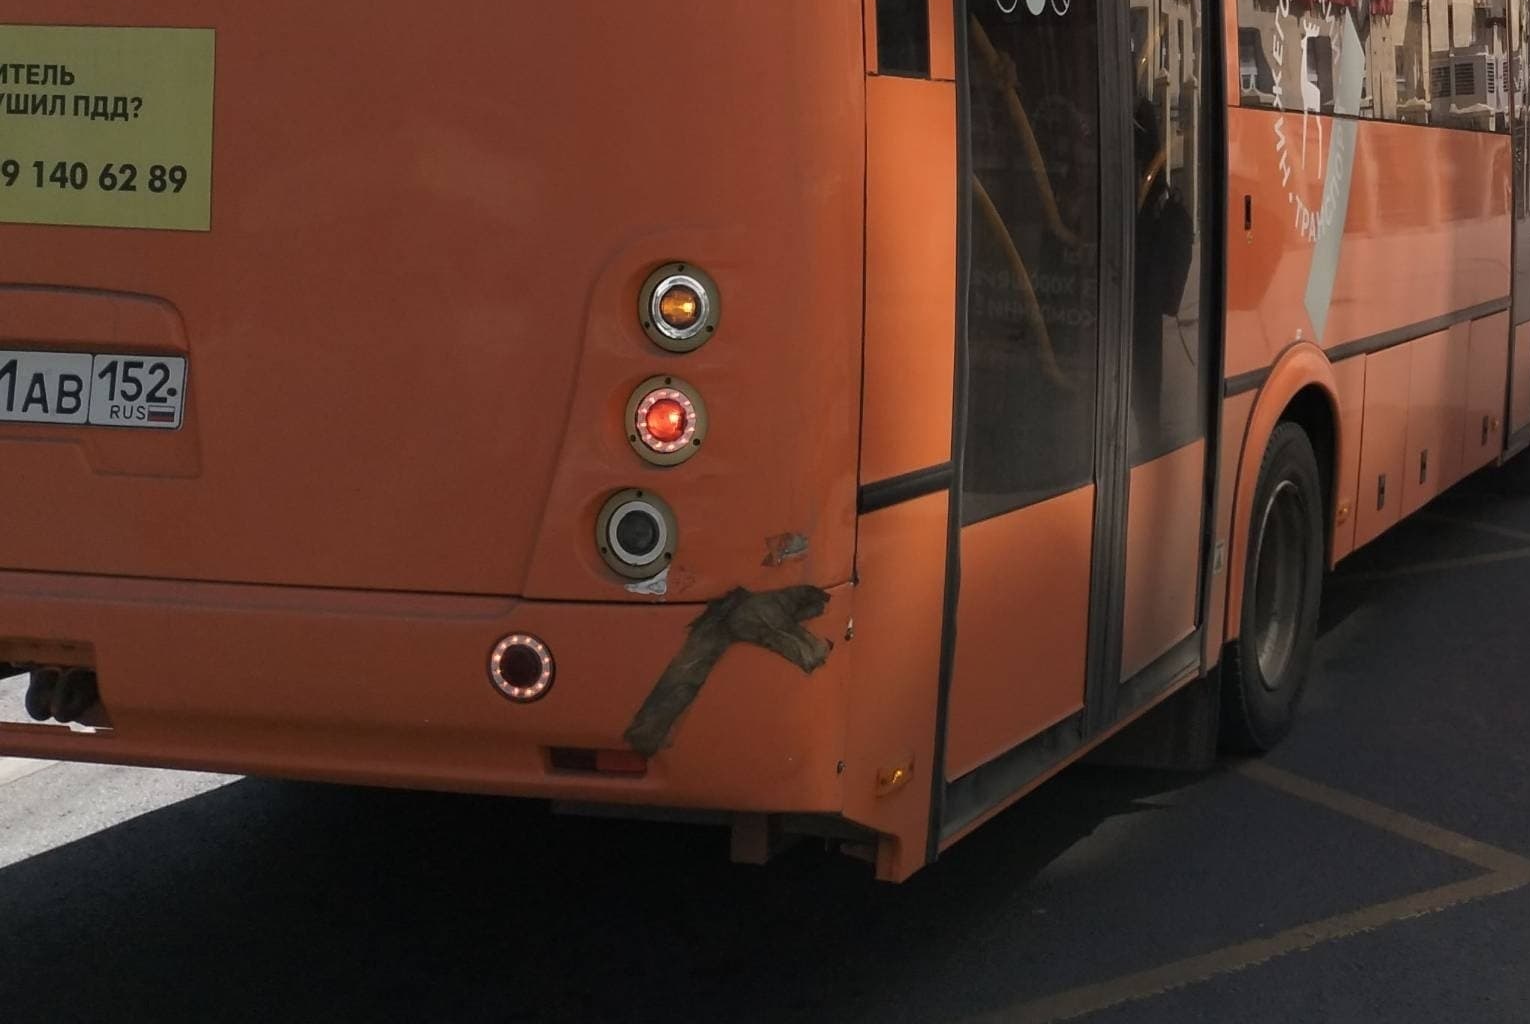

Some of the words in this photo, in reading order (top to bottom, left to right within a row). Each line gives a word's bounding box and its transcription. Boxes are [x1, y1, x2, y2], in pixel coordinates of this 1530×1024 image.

[73, 94, 144, 121] ПДД?
[32, 160, 89, 191] 140
[98, 162, 138, 192] 62
[147, 163, 188, 193] 89
[97, 361, 171, 404] 152
[109, 404, 147, 420] RUS
